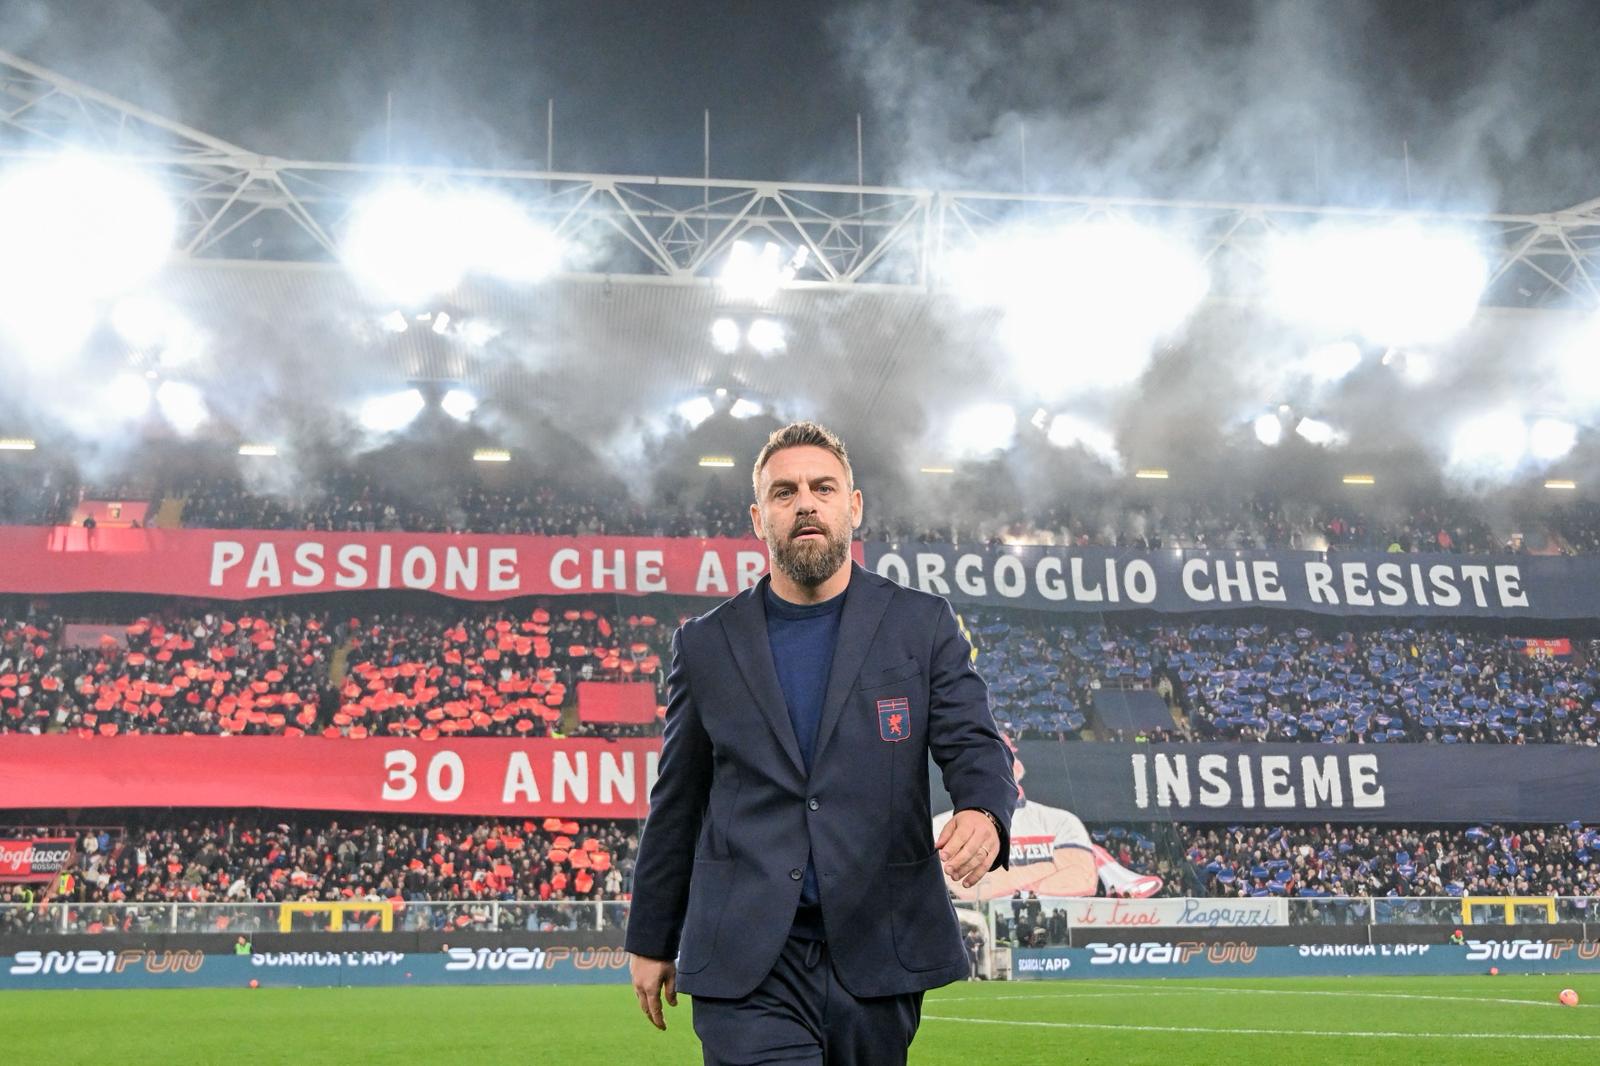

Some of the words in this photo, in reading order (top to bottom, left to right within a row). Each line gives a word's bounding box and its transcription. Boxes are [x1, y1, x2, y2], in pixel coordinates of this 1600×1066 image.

[209, 541, 521, 589] PASSIONE
[549, 547, 667, 593] CHE
[695, 550, 768, 593] AR
[876, 552, 1157, 603] ORGOGLIO
[1182, 559, 1287, 603] CHE
[1309, 561, 1530, 608] RESISTE
[382, 750, 465, 803] 30
[502, 751, 660, 805] ANNI
[1132, 753, 1385, 810] INSIEME
[1177, 898, 1278, 927] Ragazzi
